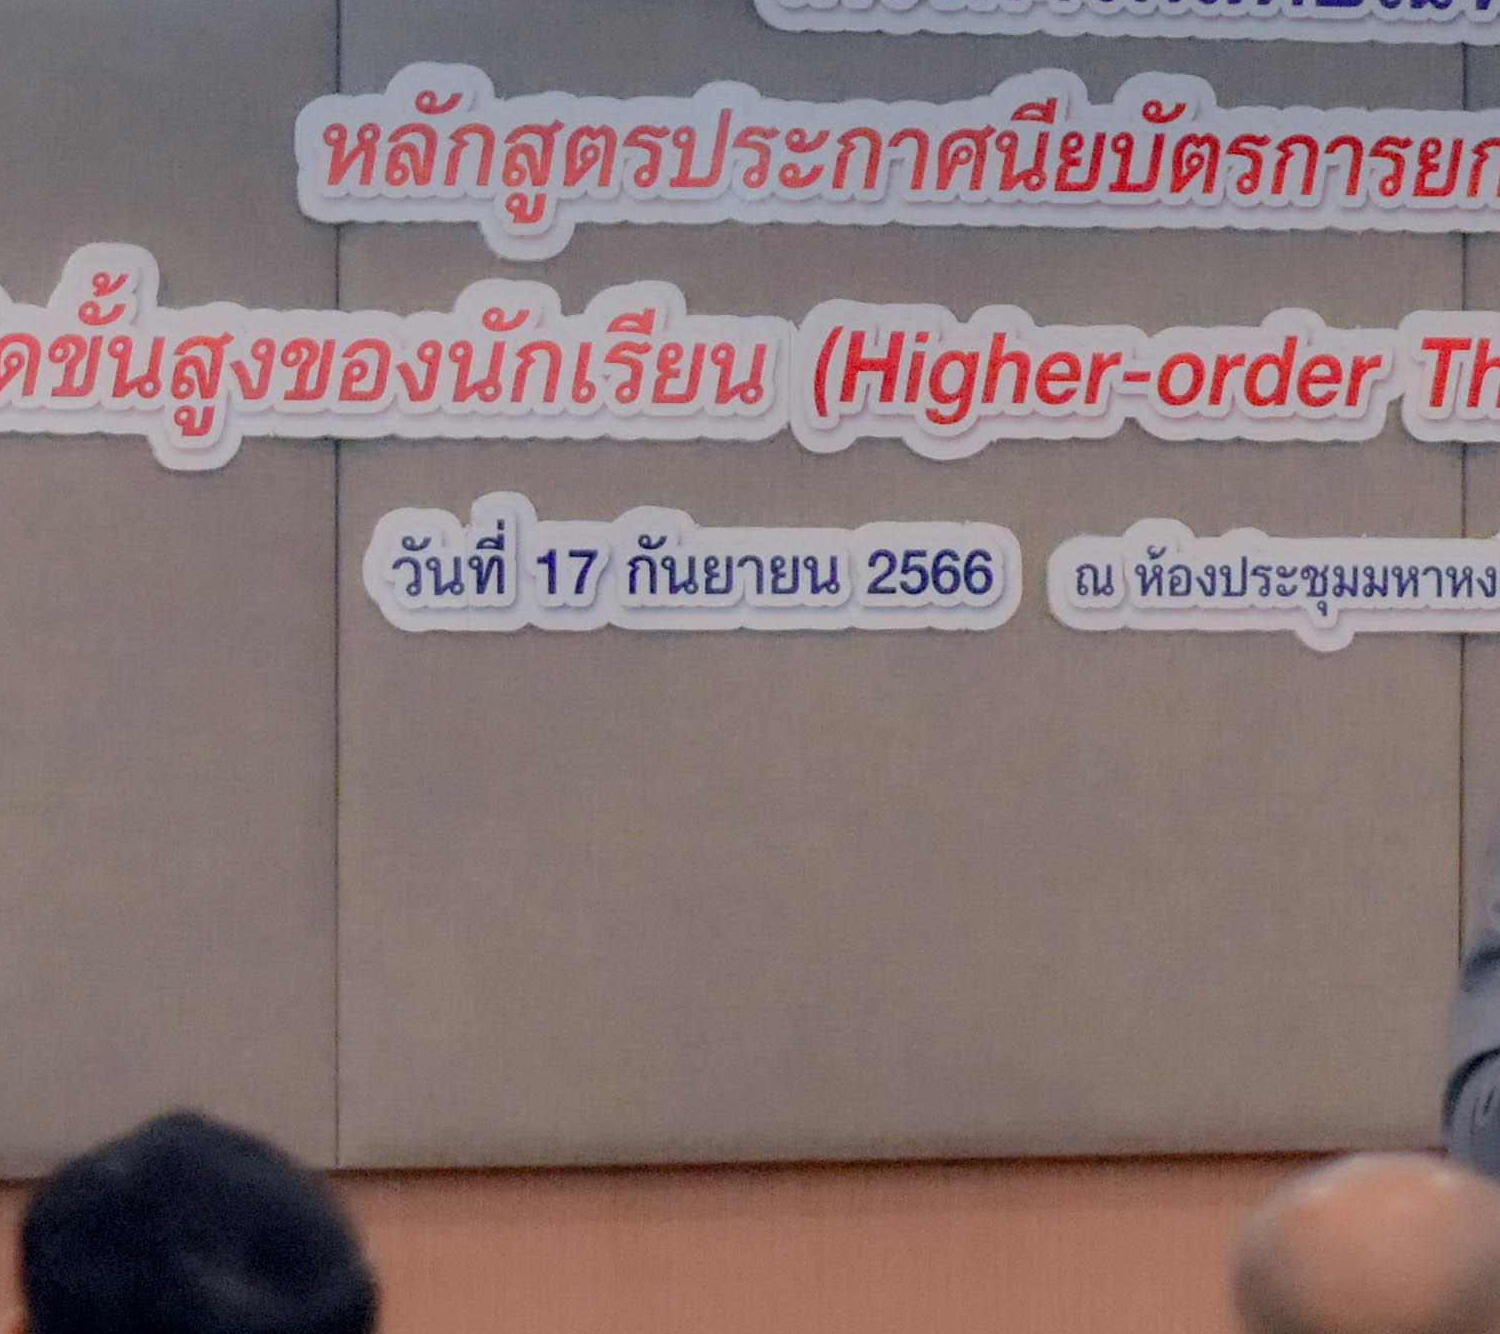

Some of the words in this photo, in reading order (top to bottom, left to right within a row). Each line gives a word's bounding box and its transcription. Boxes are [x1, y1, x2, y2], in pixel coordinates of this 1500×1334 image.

[812, 325, 1384, 427] (Higher-order
[392, 520, 506, 595] วันที่
[536, 548, 599, 595] 17
[627, 533, 839, 595] กันยายน
[867, 548, 994, 596] 2566
[1075, 564, 1114, 599] ณ
